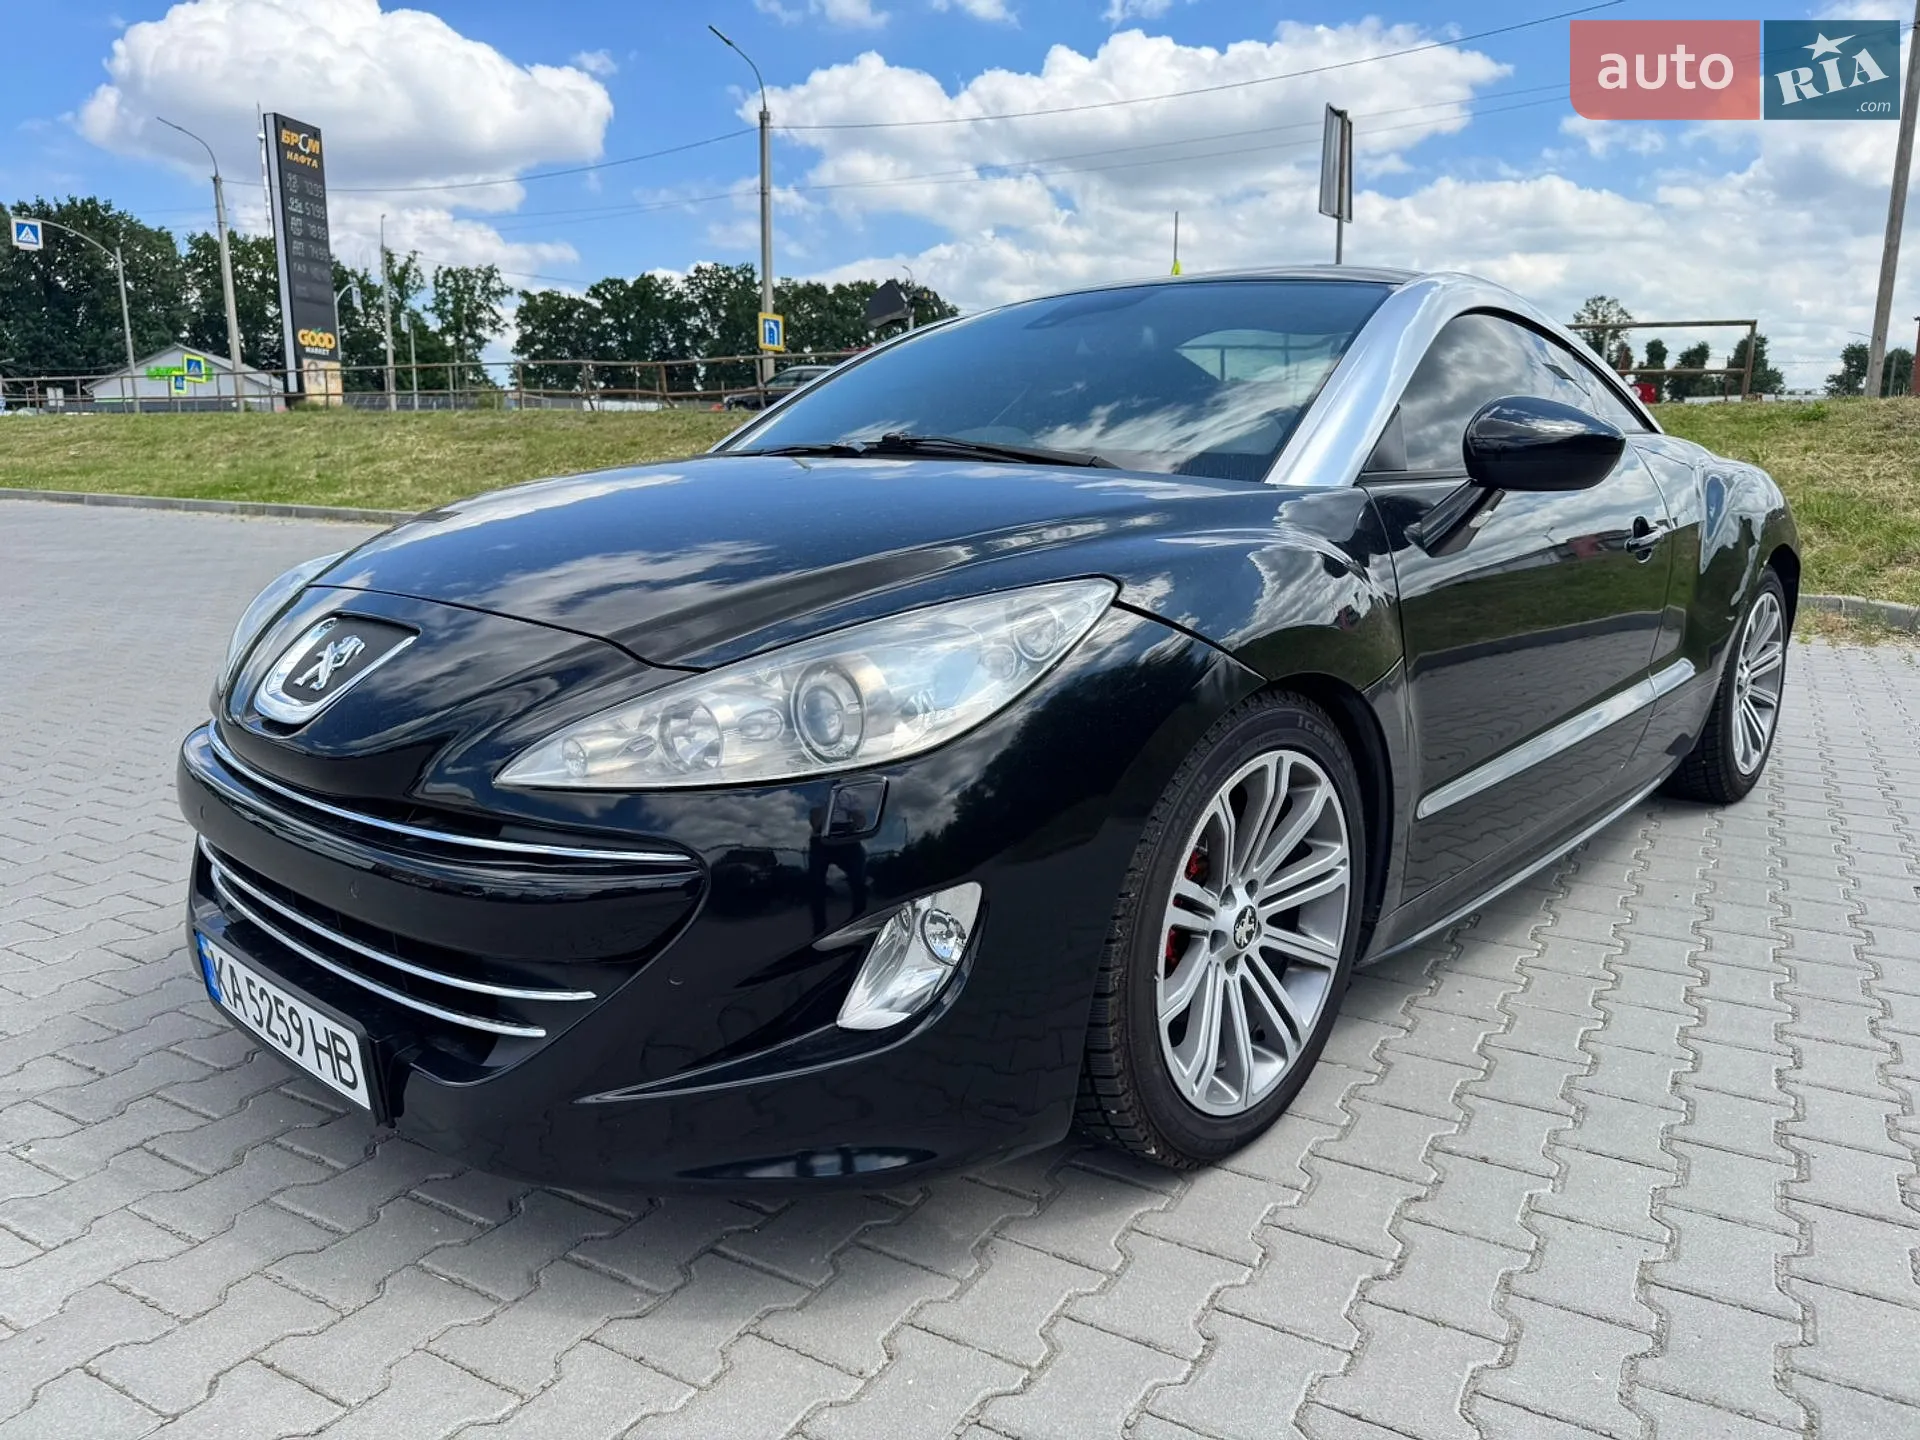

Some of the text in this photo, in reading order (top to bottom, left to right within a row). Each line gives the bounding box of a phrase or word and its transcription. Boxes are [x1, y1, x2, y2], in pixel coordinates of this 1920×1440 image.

[286, 150, 318, 169] НАФТА
[298, 329, 336, 350] GOOD
[246, 976, 304, 1057] 5259
[308, 1016, 358, 1091] HB
